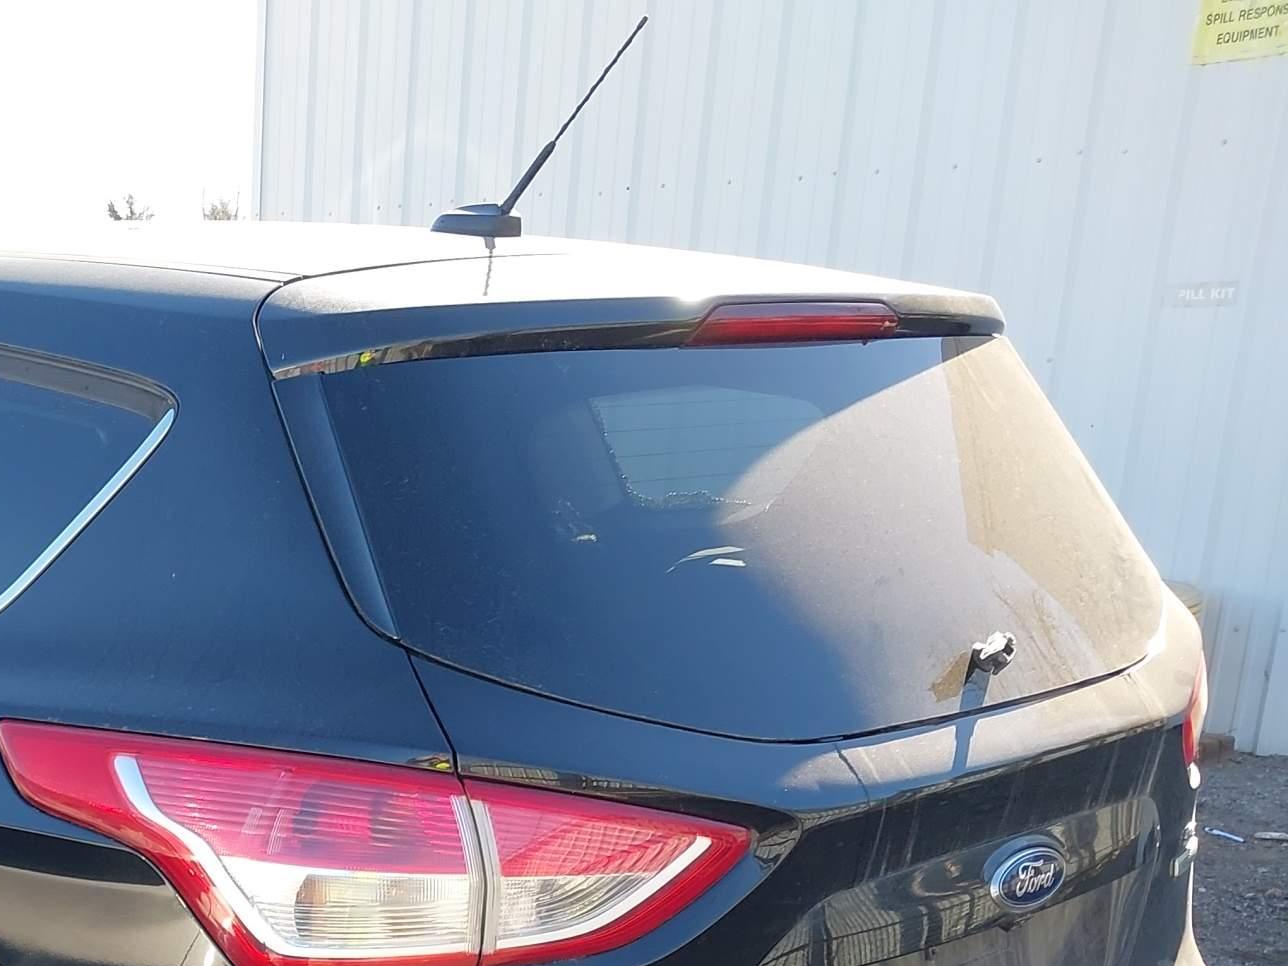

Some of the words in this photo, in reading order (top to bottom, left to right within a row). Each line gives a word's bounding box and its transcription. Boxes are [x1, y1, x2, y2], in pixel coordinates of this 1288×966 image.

[1205, 11, 1235, 26] SPILL
[1216, 25, 1280, 45] EQUIPMENT
[1211, 287, 1235, 300] KIT
[1015, 858, 1055, 898] Ford
